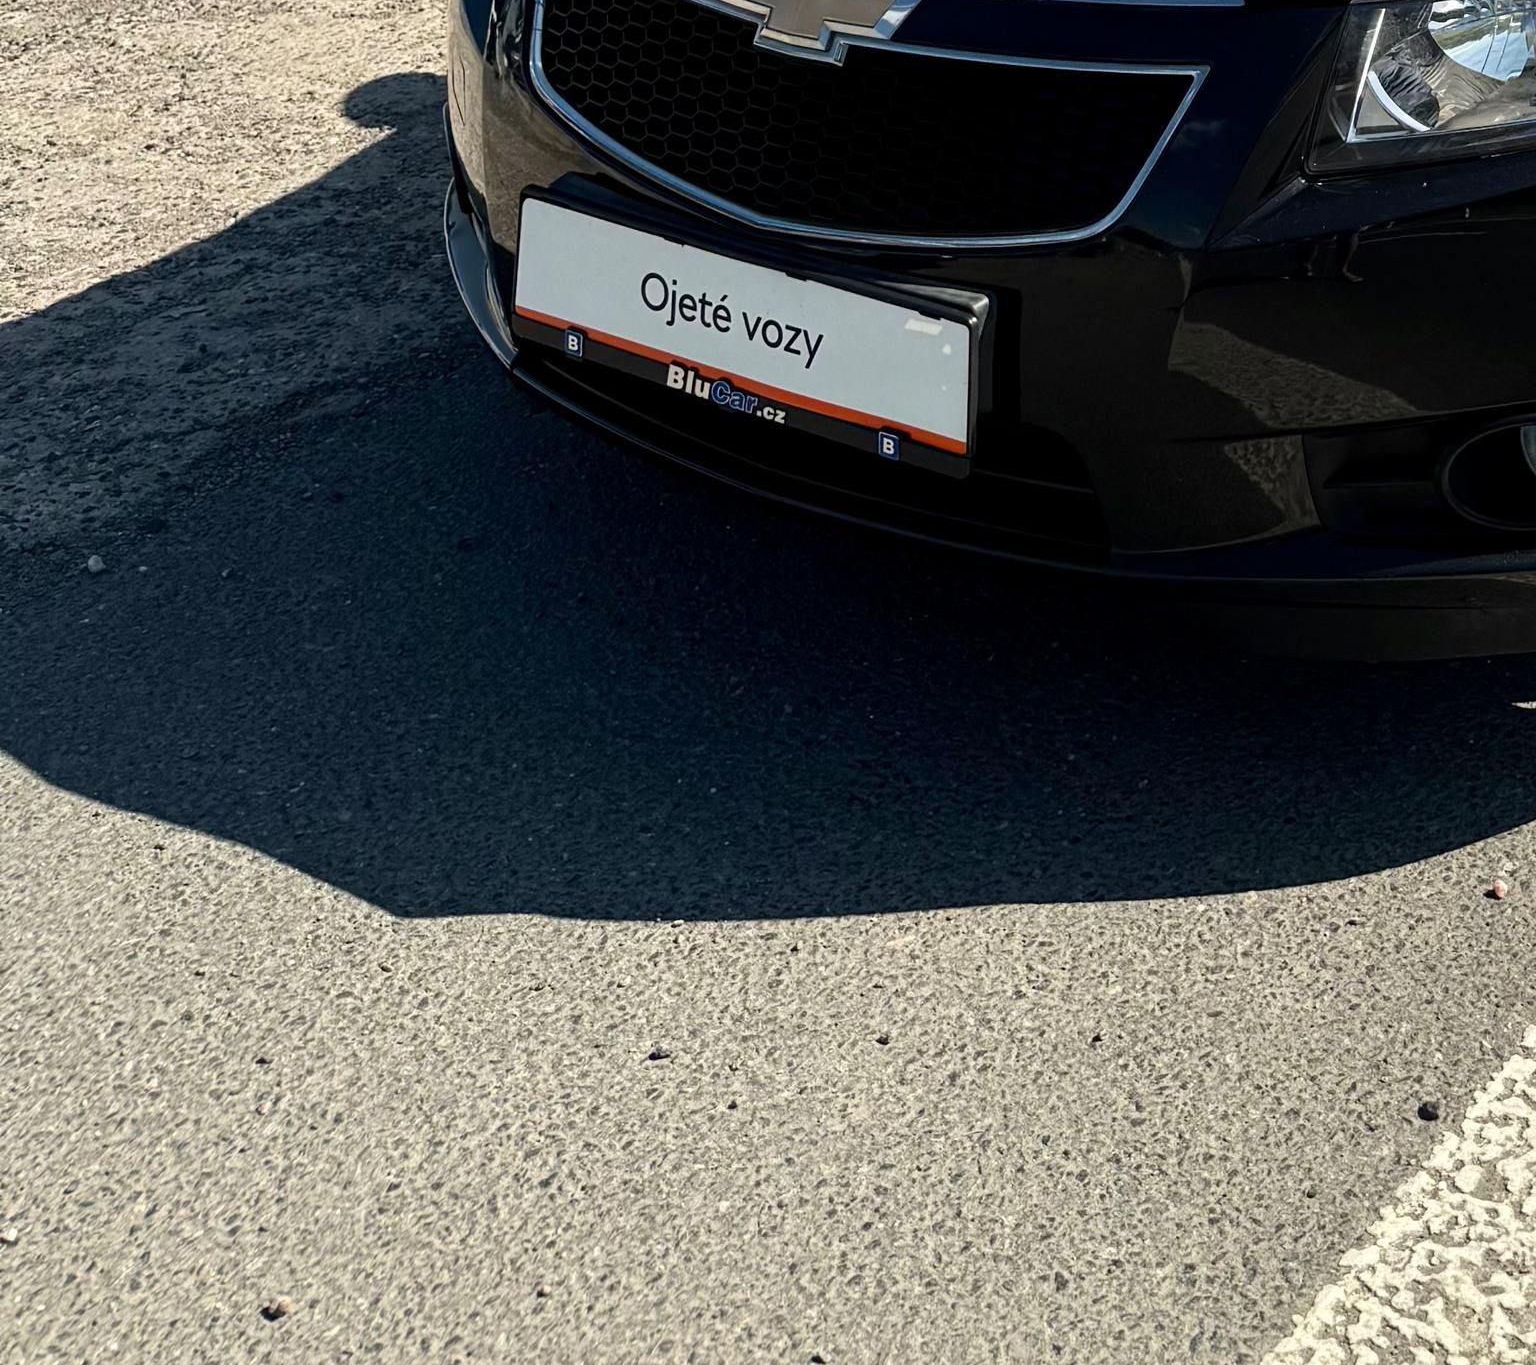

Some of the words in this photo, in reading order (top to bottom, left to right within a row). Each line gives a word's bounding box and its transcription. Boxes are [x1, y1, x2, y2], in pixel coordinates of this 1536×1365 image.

[641, 272, 732, 332] Ojeté
[742, 312, 824, 369] vozy
[568, 334, 579, 351] B
[666, 364, 787, 424] BluCar.cz
[882, 437, 895, 455] B
